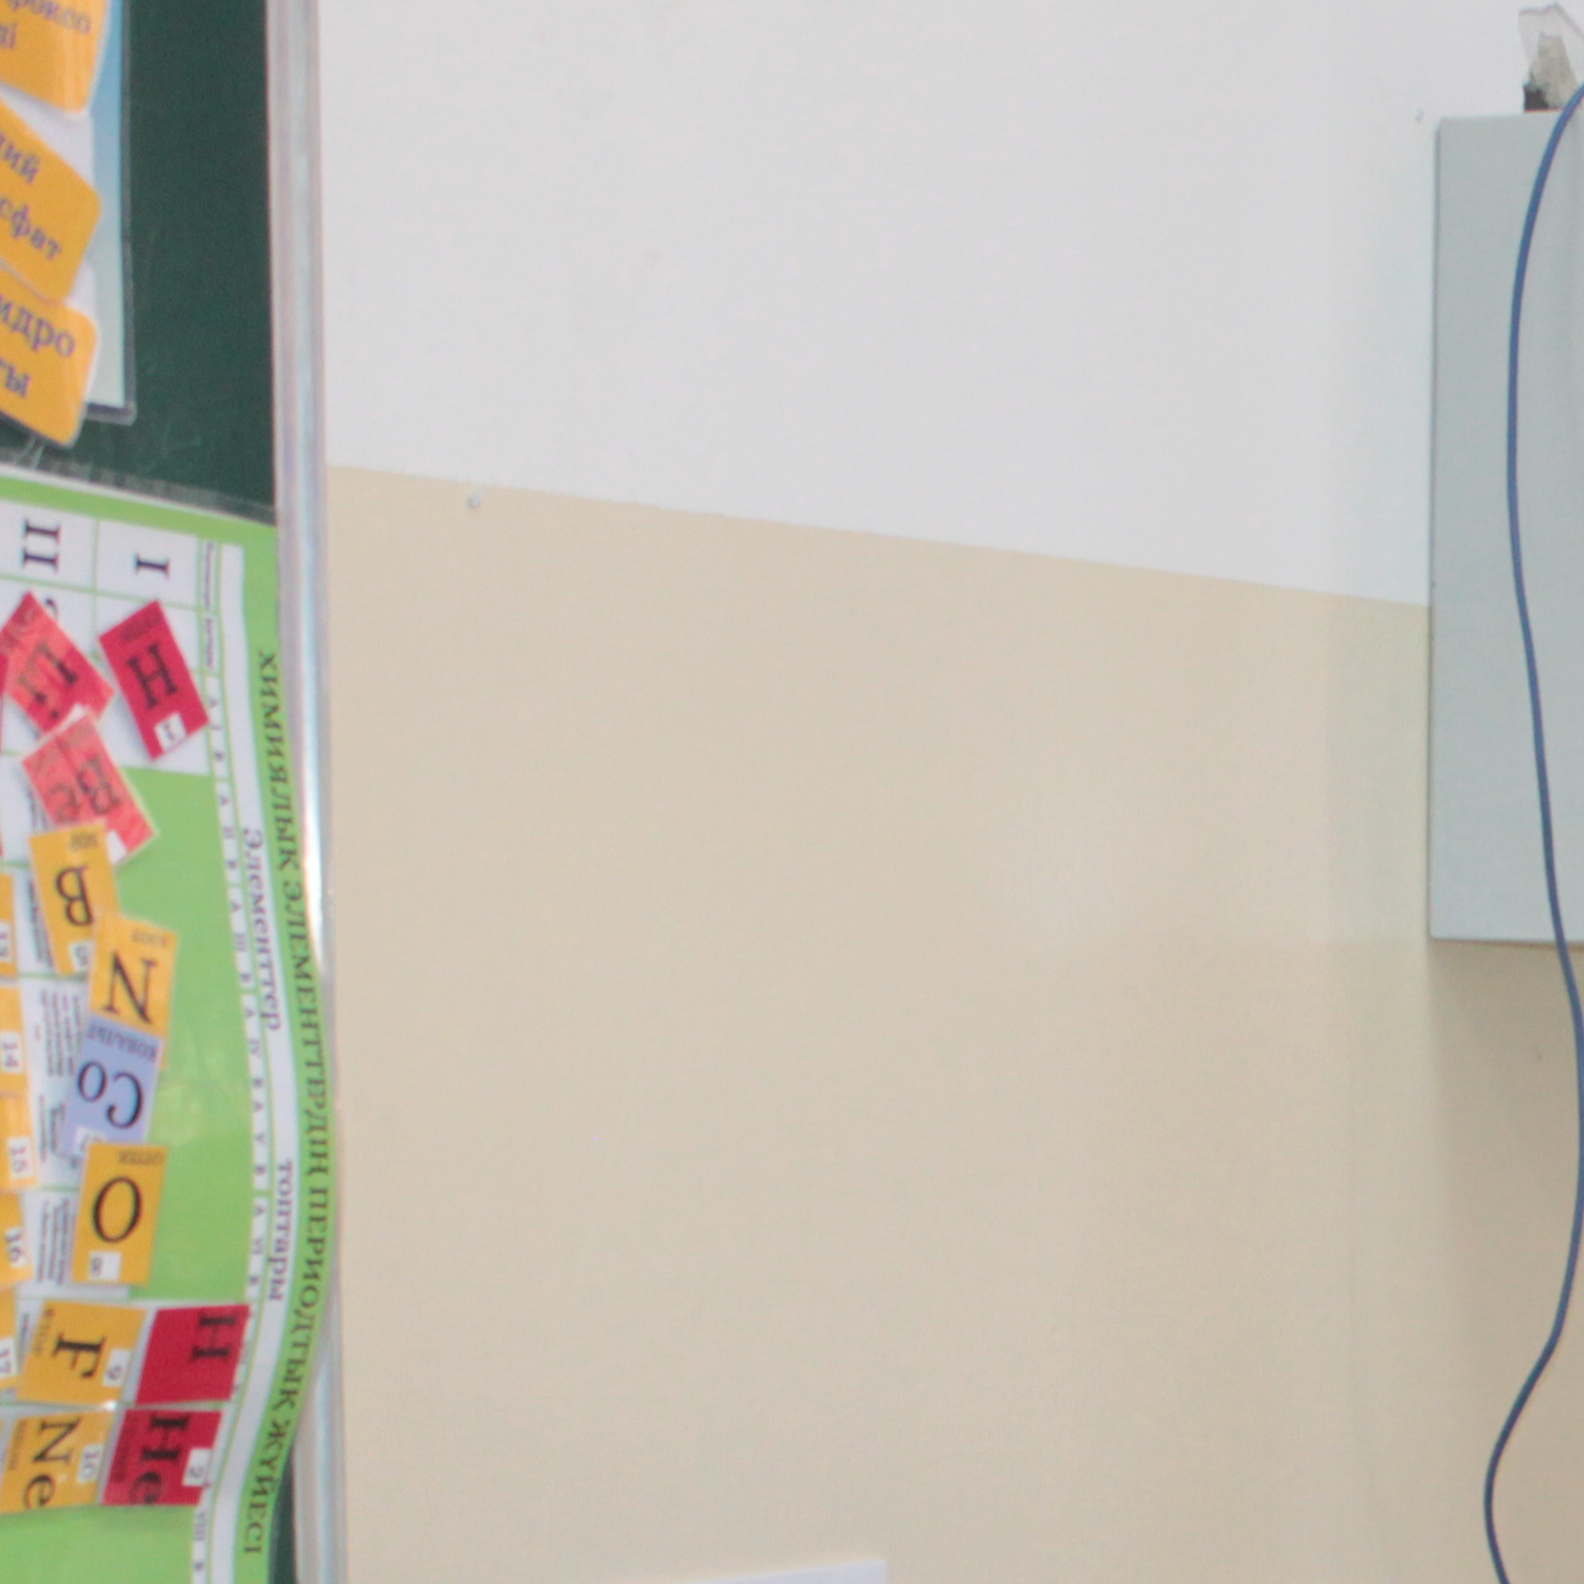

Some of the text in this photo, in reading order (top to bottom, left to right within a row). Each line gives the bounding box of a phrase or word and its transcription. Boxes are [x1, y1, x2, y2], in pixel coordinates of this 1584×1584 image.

[22, 518, 61, 574] II
[133, 553, 170, 579] I
[55, 865, 95, 927] B
[103, 951, 157, 1024] N
[78, 1061, 144, 1129] Co
[268, 1160, 292, 1300] топтары
[52, 1333, 107, 1379] F
[22, 1417, 82, 1509] Ne
